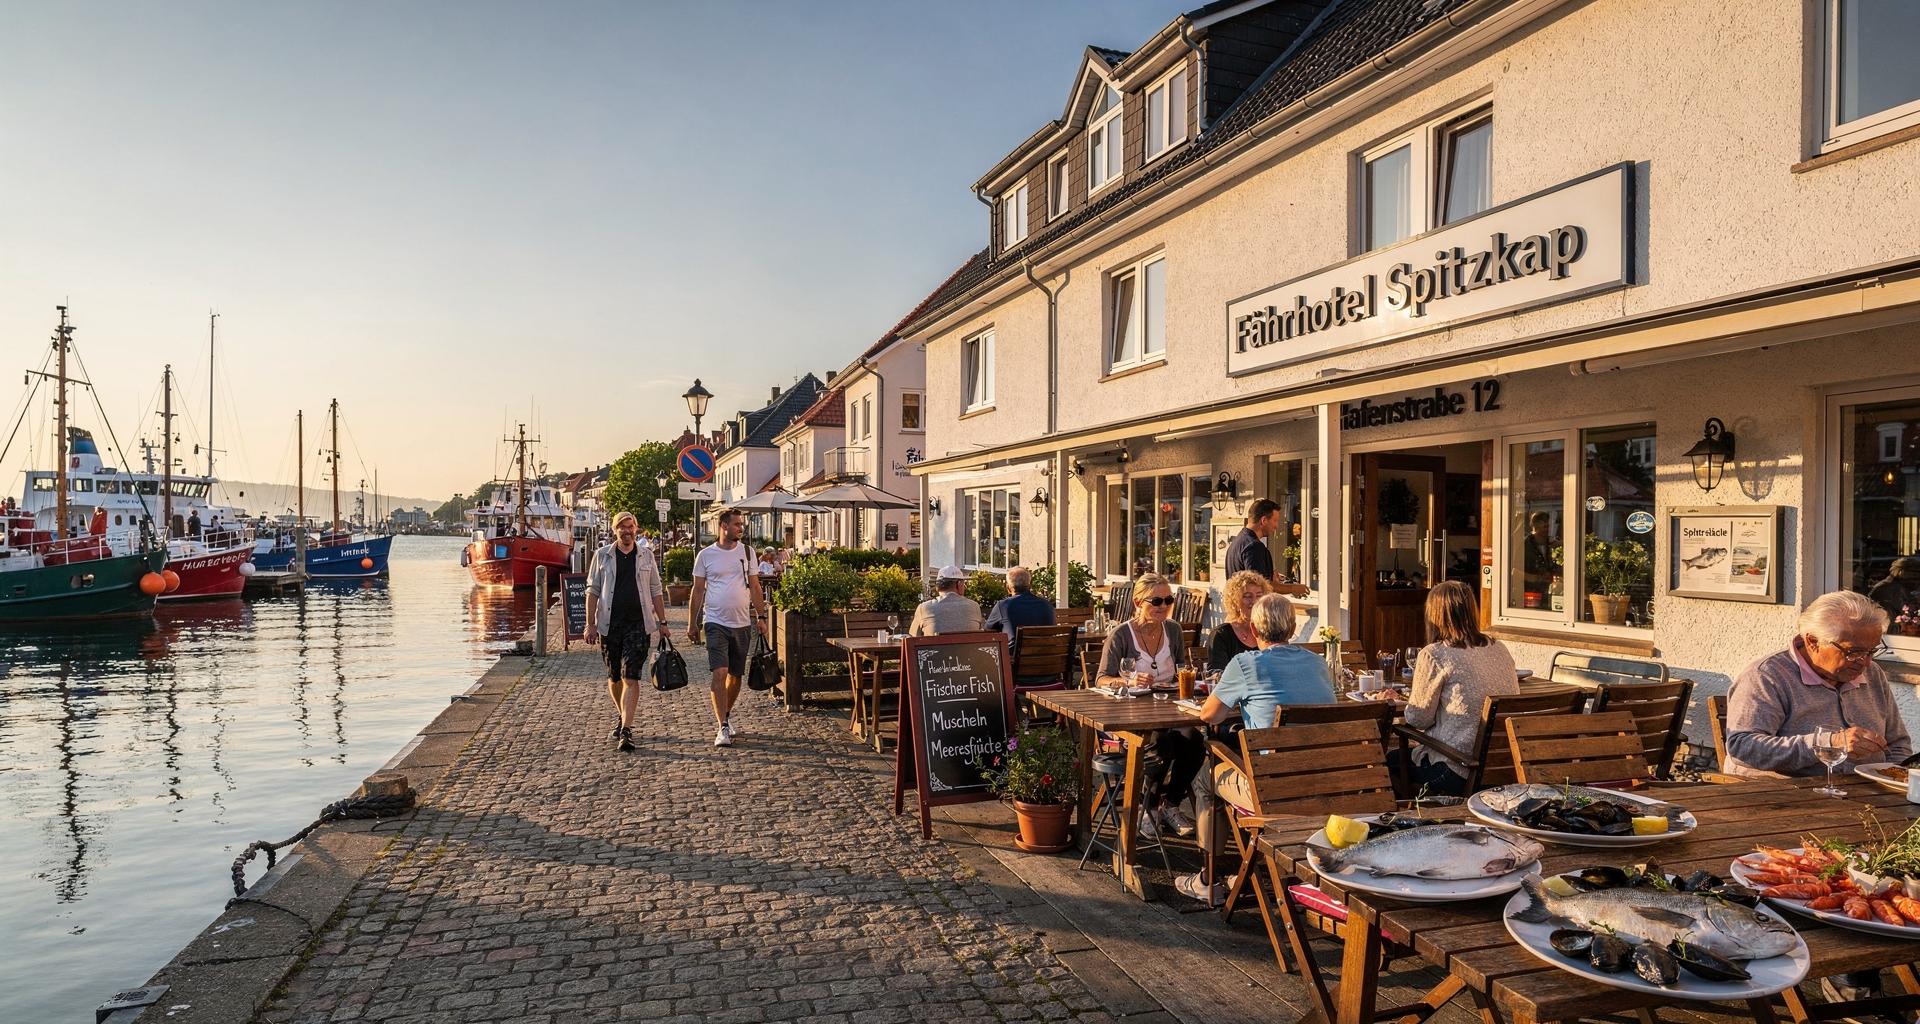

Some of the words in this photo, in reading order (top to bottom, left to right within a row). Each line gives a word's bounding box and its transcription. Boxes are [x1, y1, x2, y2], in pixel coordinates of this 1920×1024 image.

[1234, 275, 1378, 354] Fährhotel
[1385, 224, 1588, 318] Spitzkap
[1471, 379, 1501, 413] 12
[969, 673, 995, 694] Fish
[931, 708, 988, 732] Muscheln
